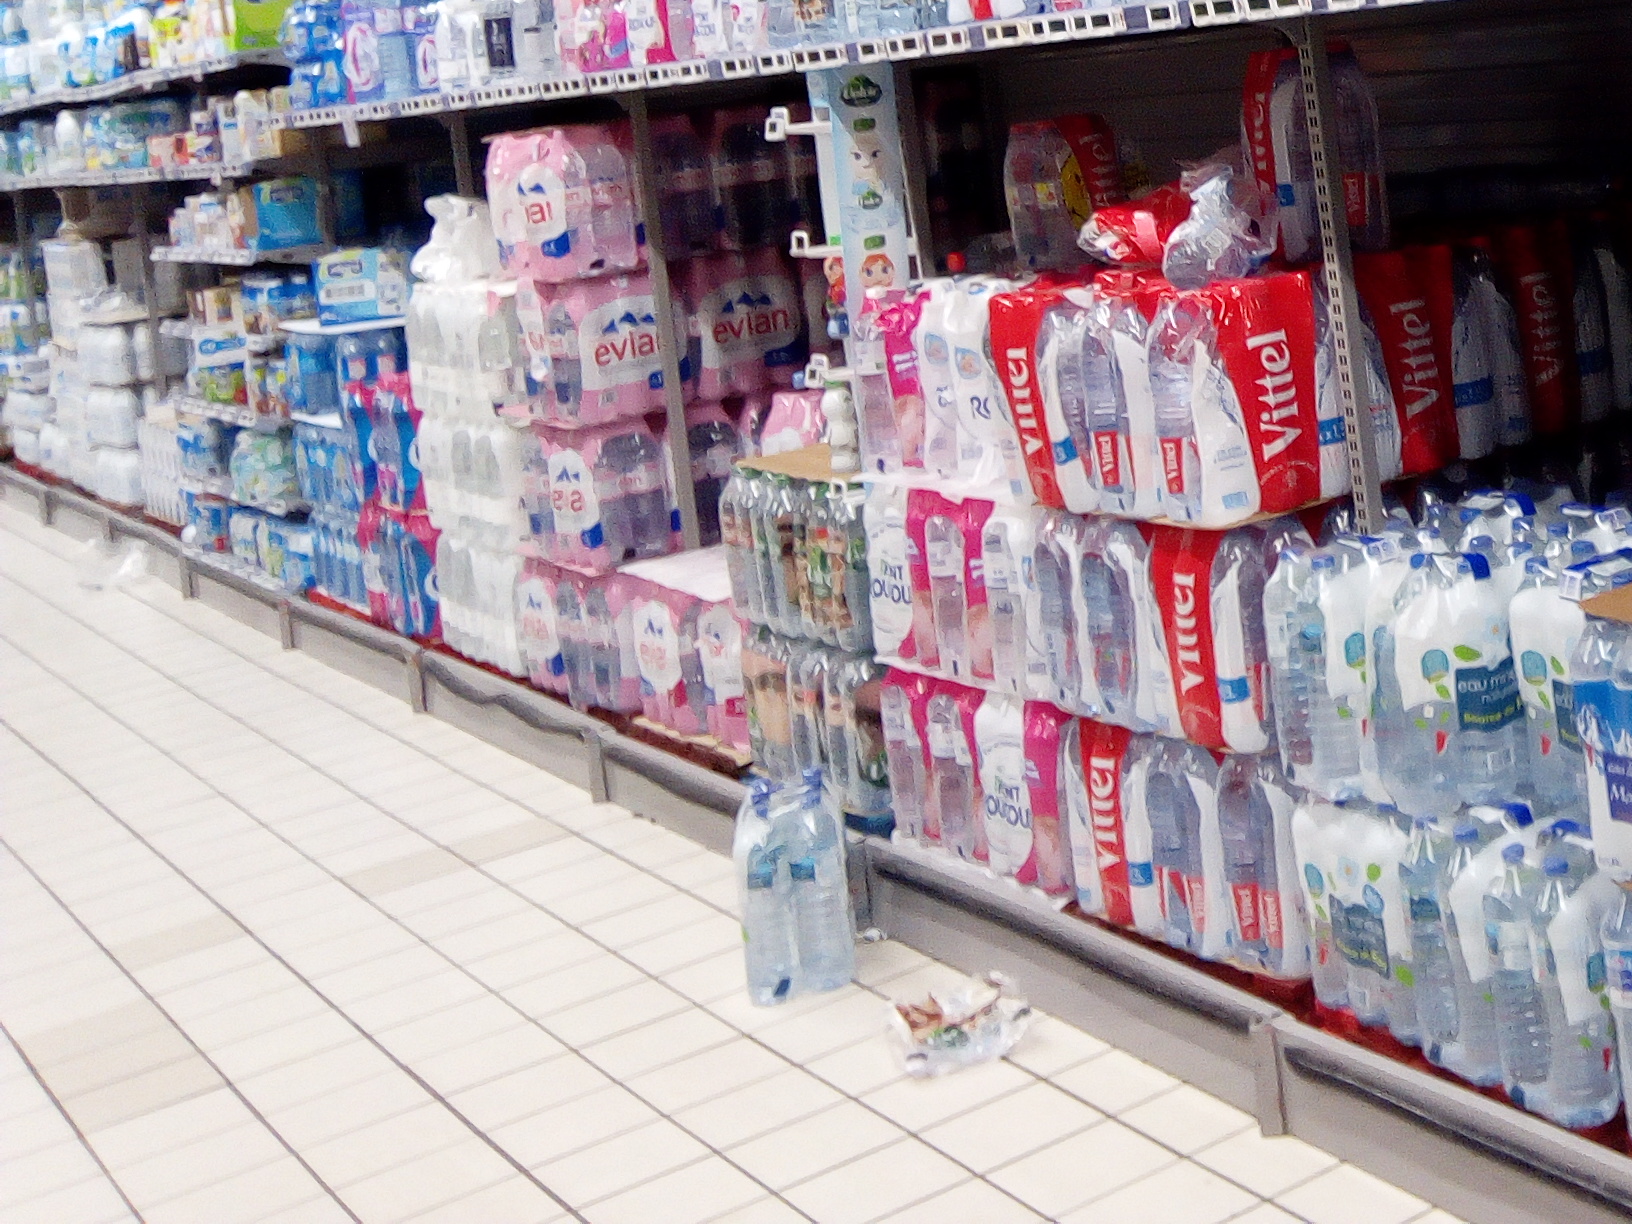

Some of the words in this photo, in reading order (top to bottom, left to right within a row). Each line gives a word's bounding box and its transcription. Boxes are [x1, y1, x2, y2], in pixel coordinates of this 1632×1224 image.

[594, 330, 657, 367] evia
[712, 308, 790, 344] evian
[1389, 297, 1440, 421] Vittel
[1246, 327, 1303, 464] Vittel
